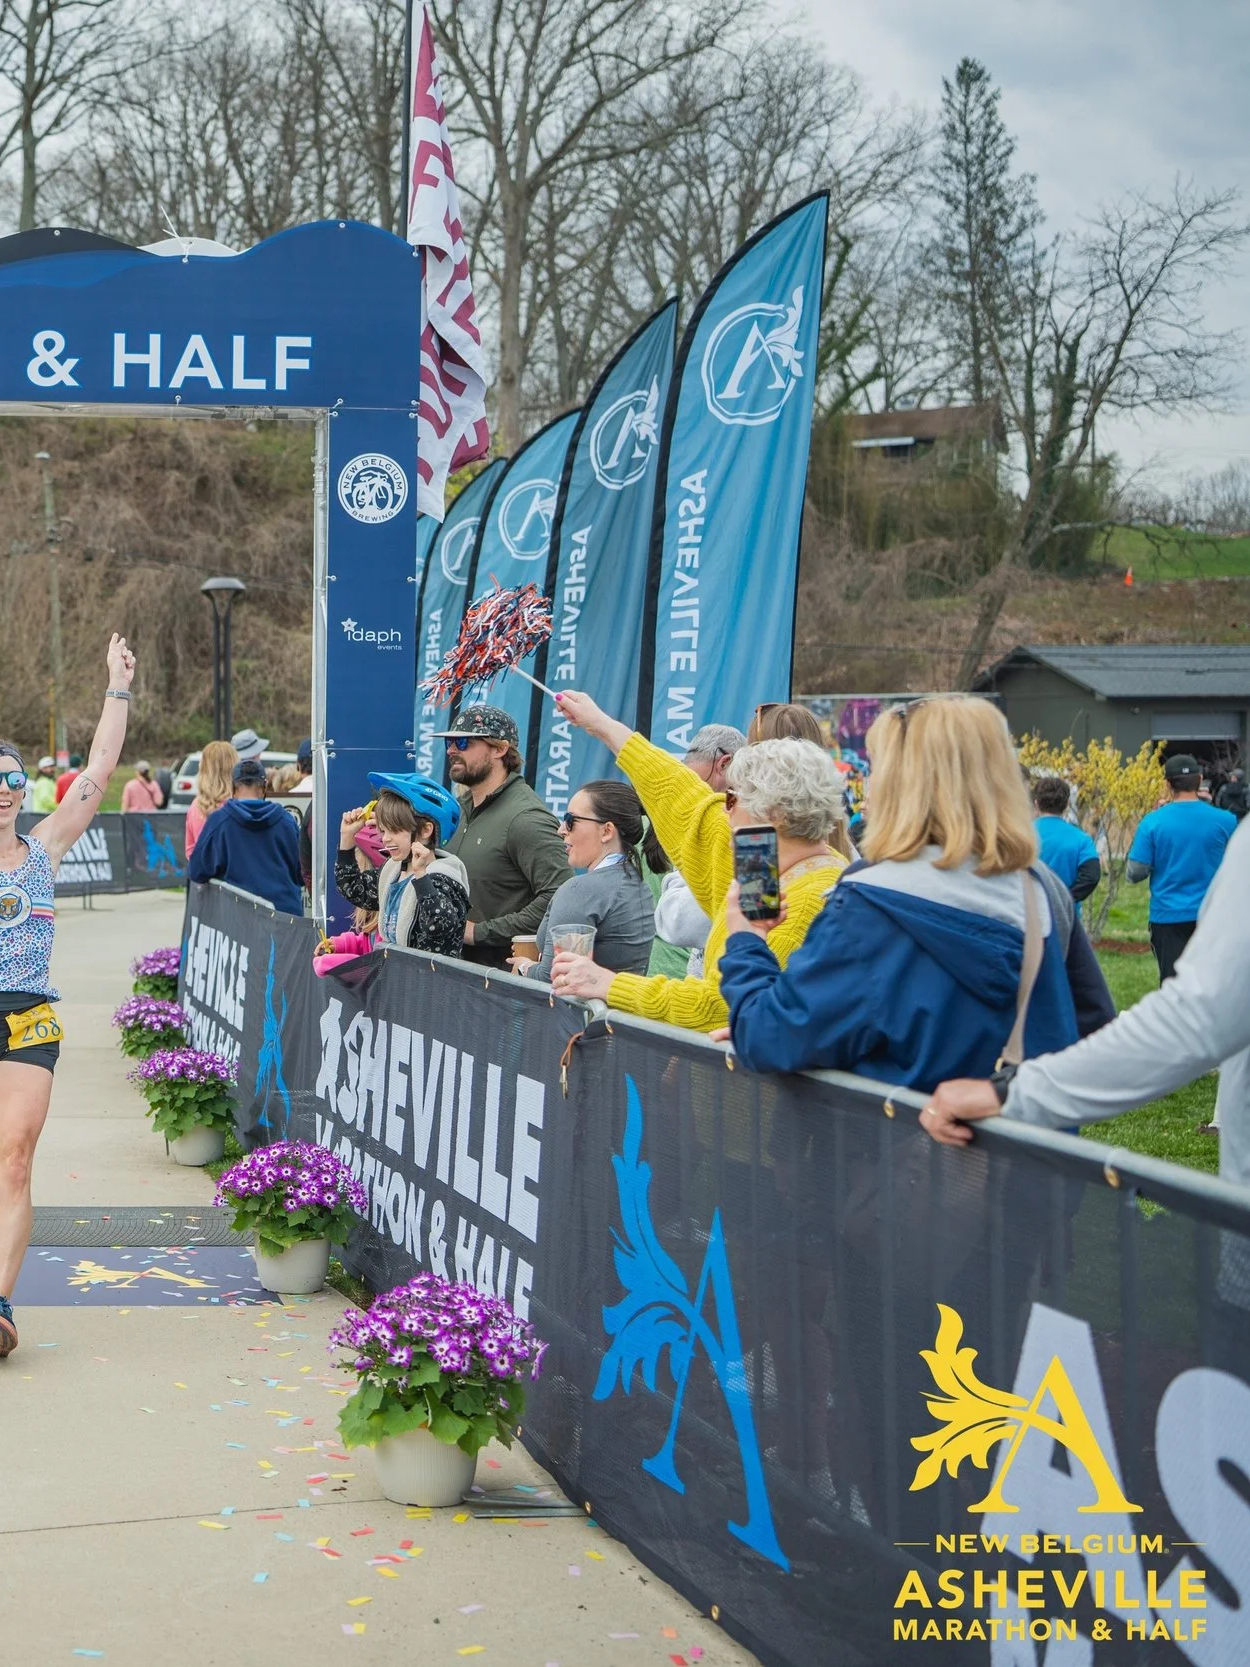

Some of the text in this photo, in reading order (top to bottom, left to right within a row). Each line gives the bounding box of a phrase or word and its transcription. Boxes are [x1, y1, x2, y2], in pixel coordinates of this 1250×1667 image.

[26, 330, 80, 387] &
[112, 332, 312, 391] HALF
[343, 458, 403, 490] NEW BELGIUM
[351, 509, 394, 522] BREWING
[344, 622, 401, 644] idaph
[21, 1016, 61, 1042] 268
[315, 997, 546, 1243] ASHEVILLE
[428, 1199, 450, 1282] &
